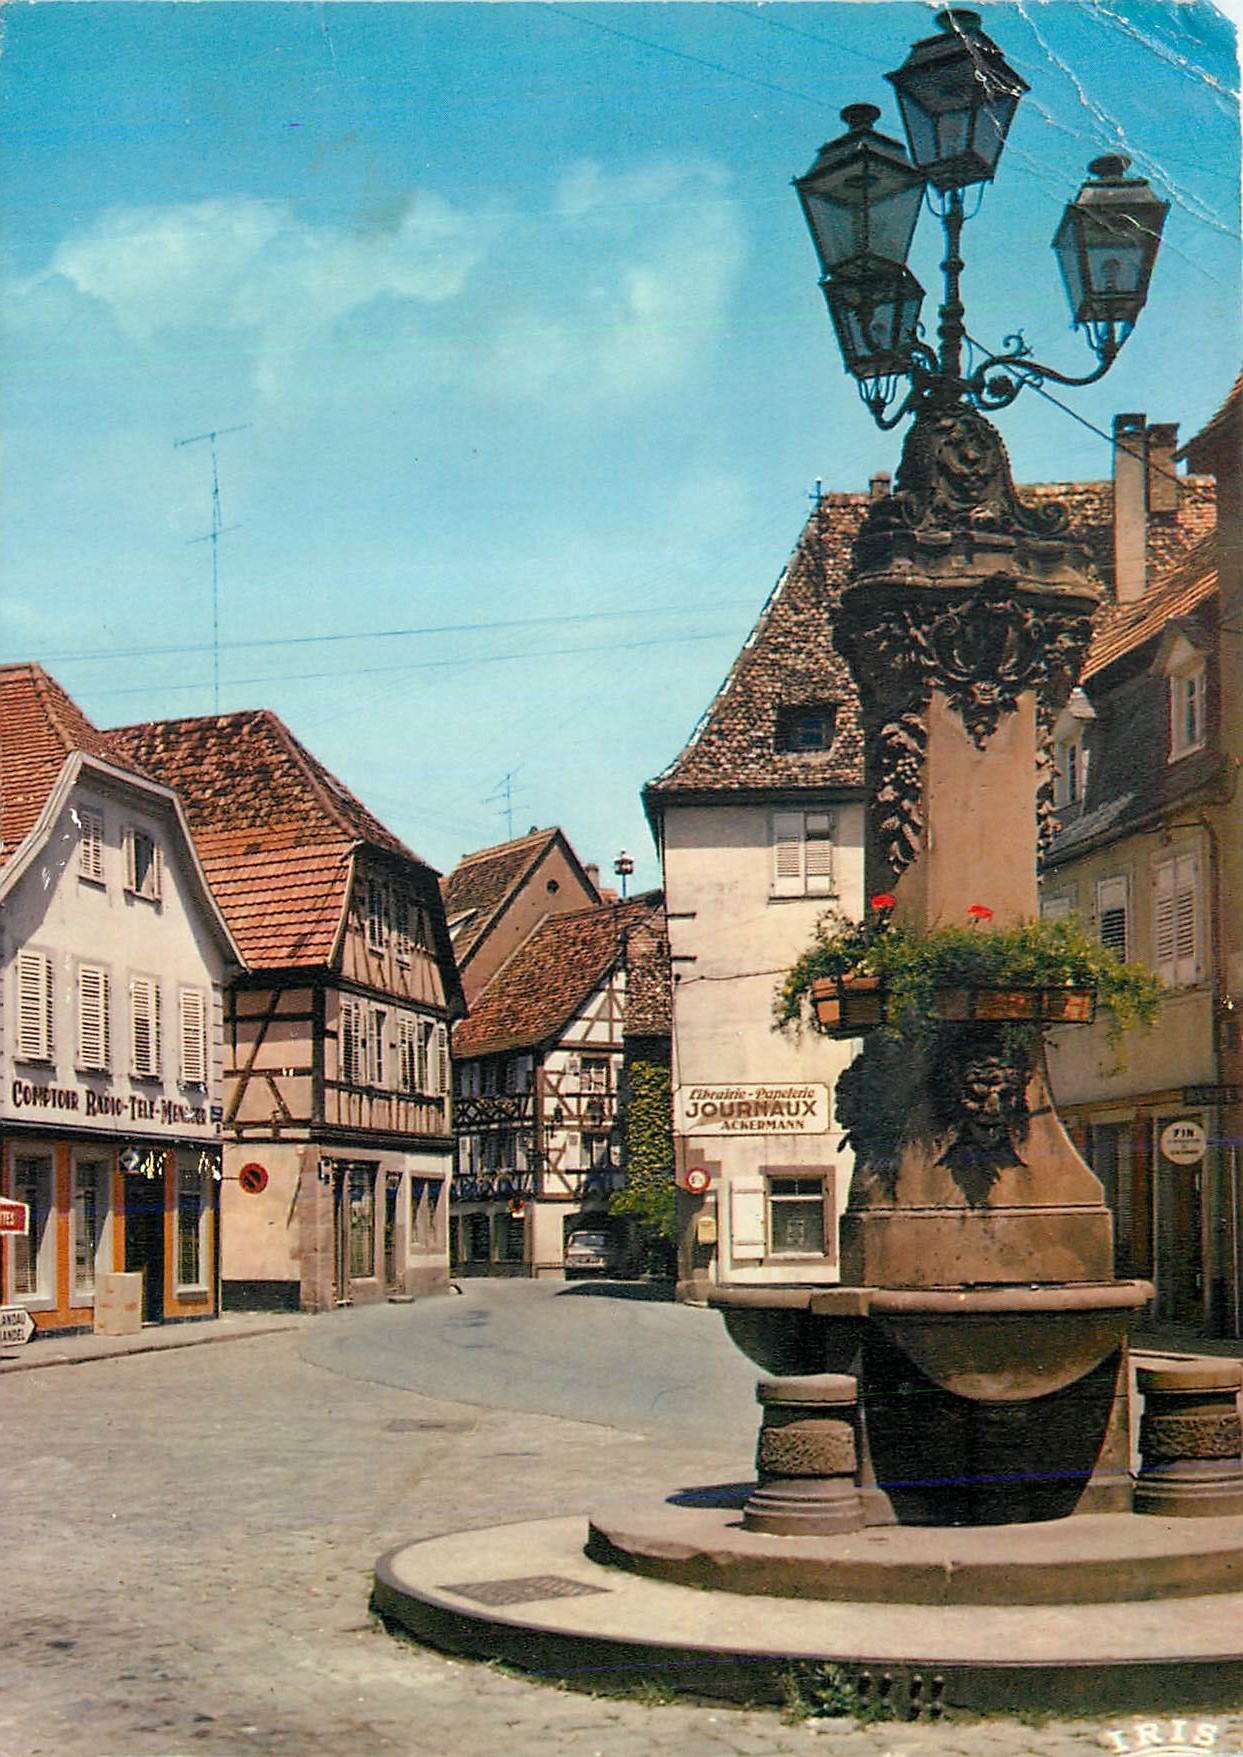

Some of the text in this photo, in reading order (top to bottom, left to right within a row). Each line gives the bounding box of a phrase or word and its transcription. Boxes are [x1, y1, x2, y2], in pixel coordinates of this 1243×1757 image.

[12, 1081, 79, 1111] COMPTOIR
[685, 1100, 817, 1118] JOURNAUX
[721, 1120, 804, 1131] ACKERMANN
[0, 1313, 26, 1326] ANDAU
[0, 1328, 25, 1342] ANDEL
